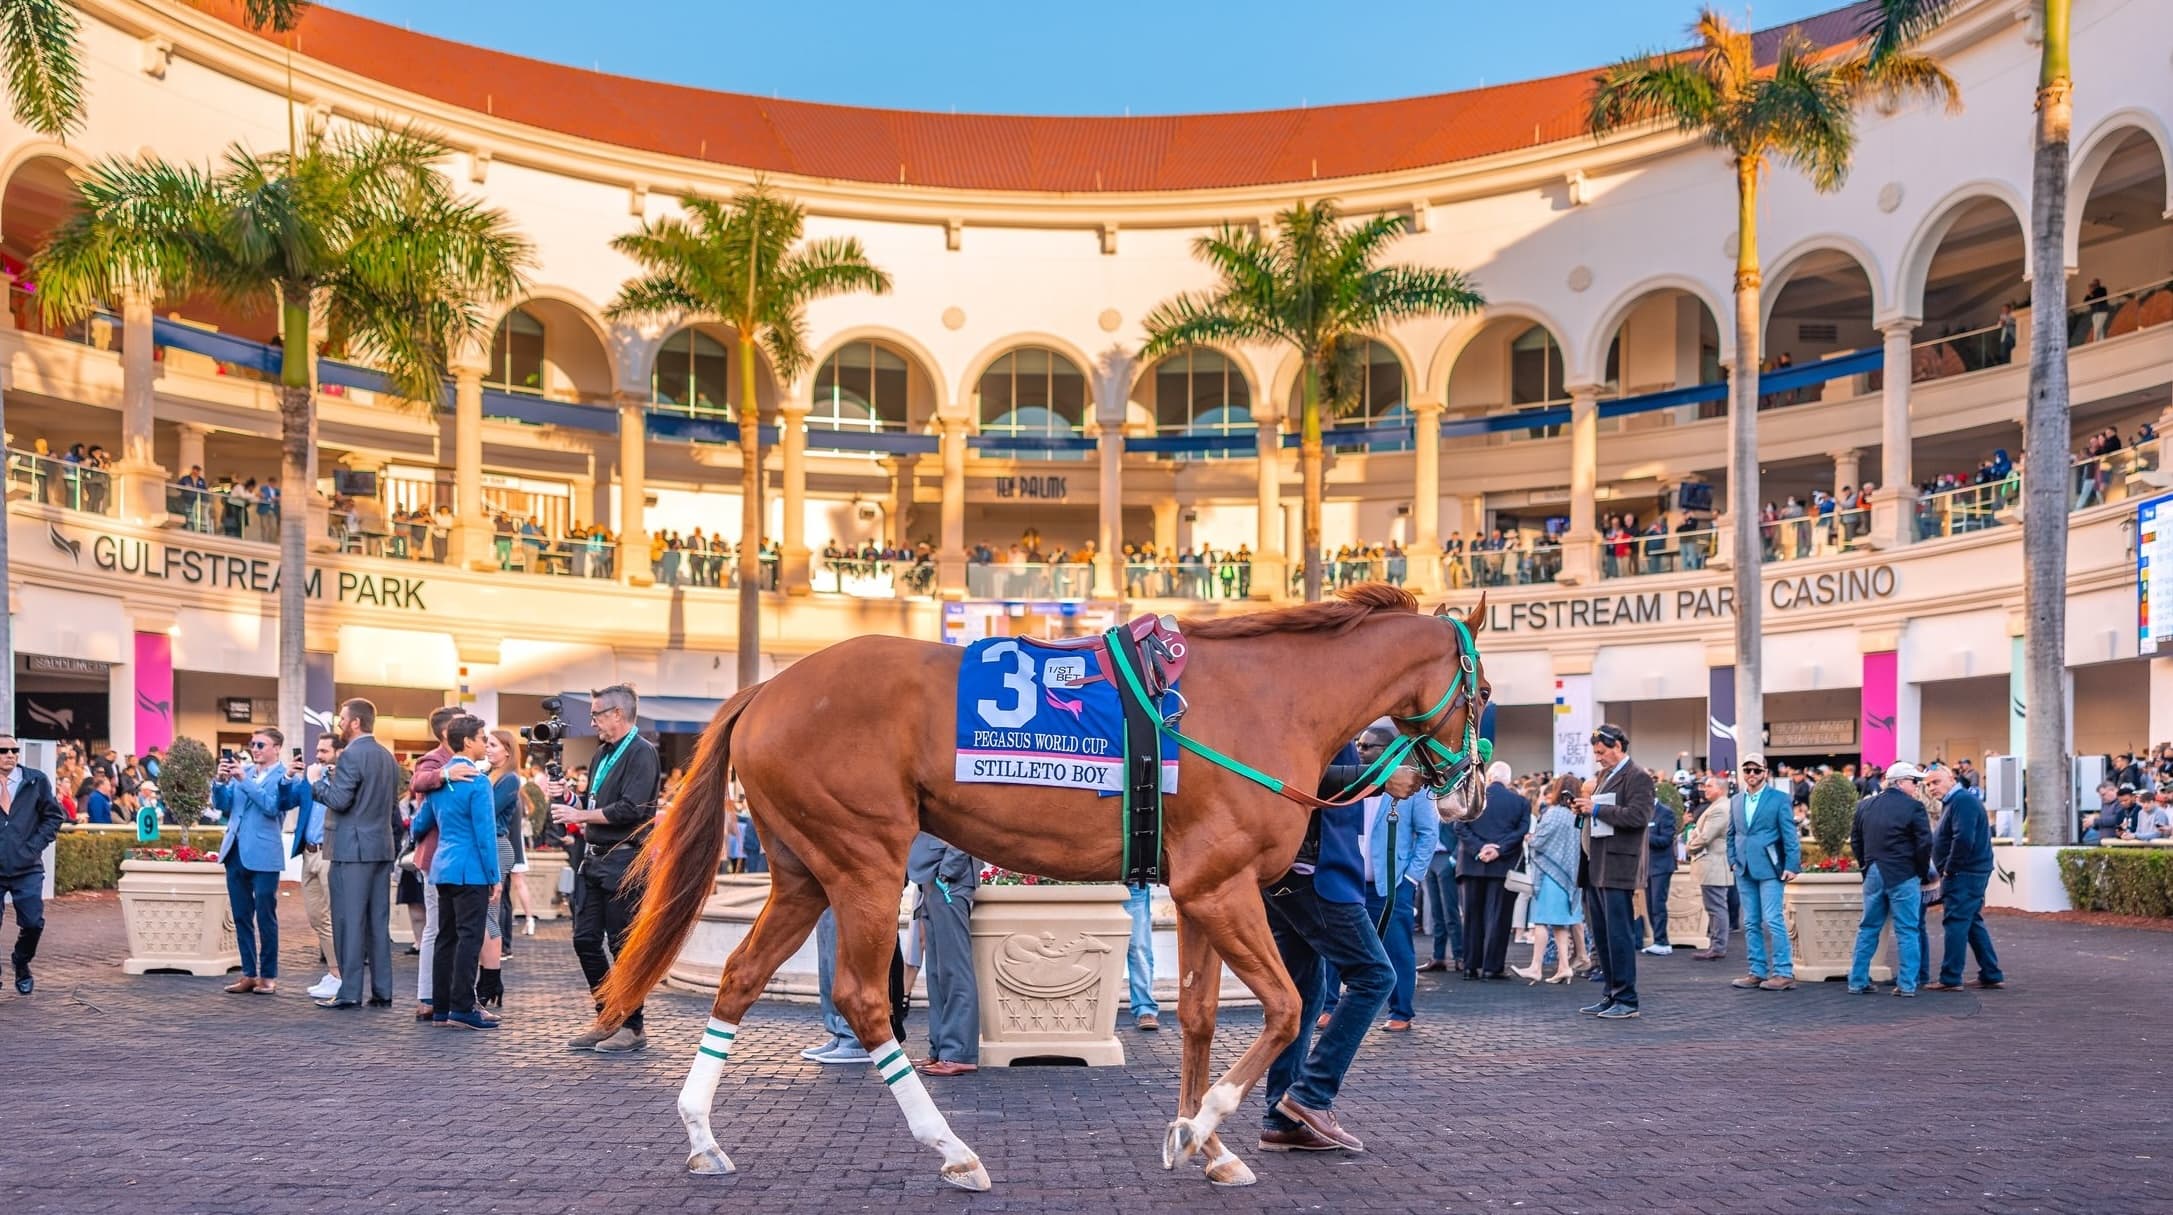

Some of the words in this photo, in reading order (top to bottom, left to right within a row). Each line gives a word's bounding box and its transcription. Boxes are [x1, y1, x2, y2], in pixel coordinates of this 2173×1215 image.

[1020, 476, 1067, 498] PALMS
[339, 571, 426, 610] PARK
[1677, 586, 1738, 619] PAR
[1770, 565, 1895, 609] CASINO
[1049, 666, 1075, 674] 1/ST
[1056, 673, 1081, 682] BET
[977, 641, 1037, 728] 3
[973, 730, 1032, 749] PEGASUS
[1034, 733, 1079, 753] WORLD
[1082, 737, 1109, 755] CUP
[1567, 745, 1588, 756] BET
[973, 760, 1067, 781] STILLETO
[1071, 765, 1109, 784] BOY
[1562, 756, 1586, 766] NOW
[144, 814, 154, 835] 9
